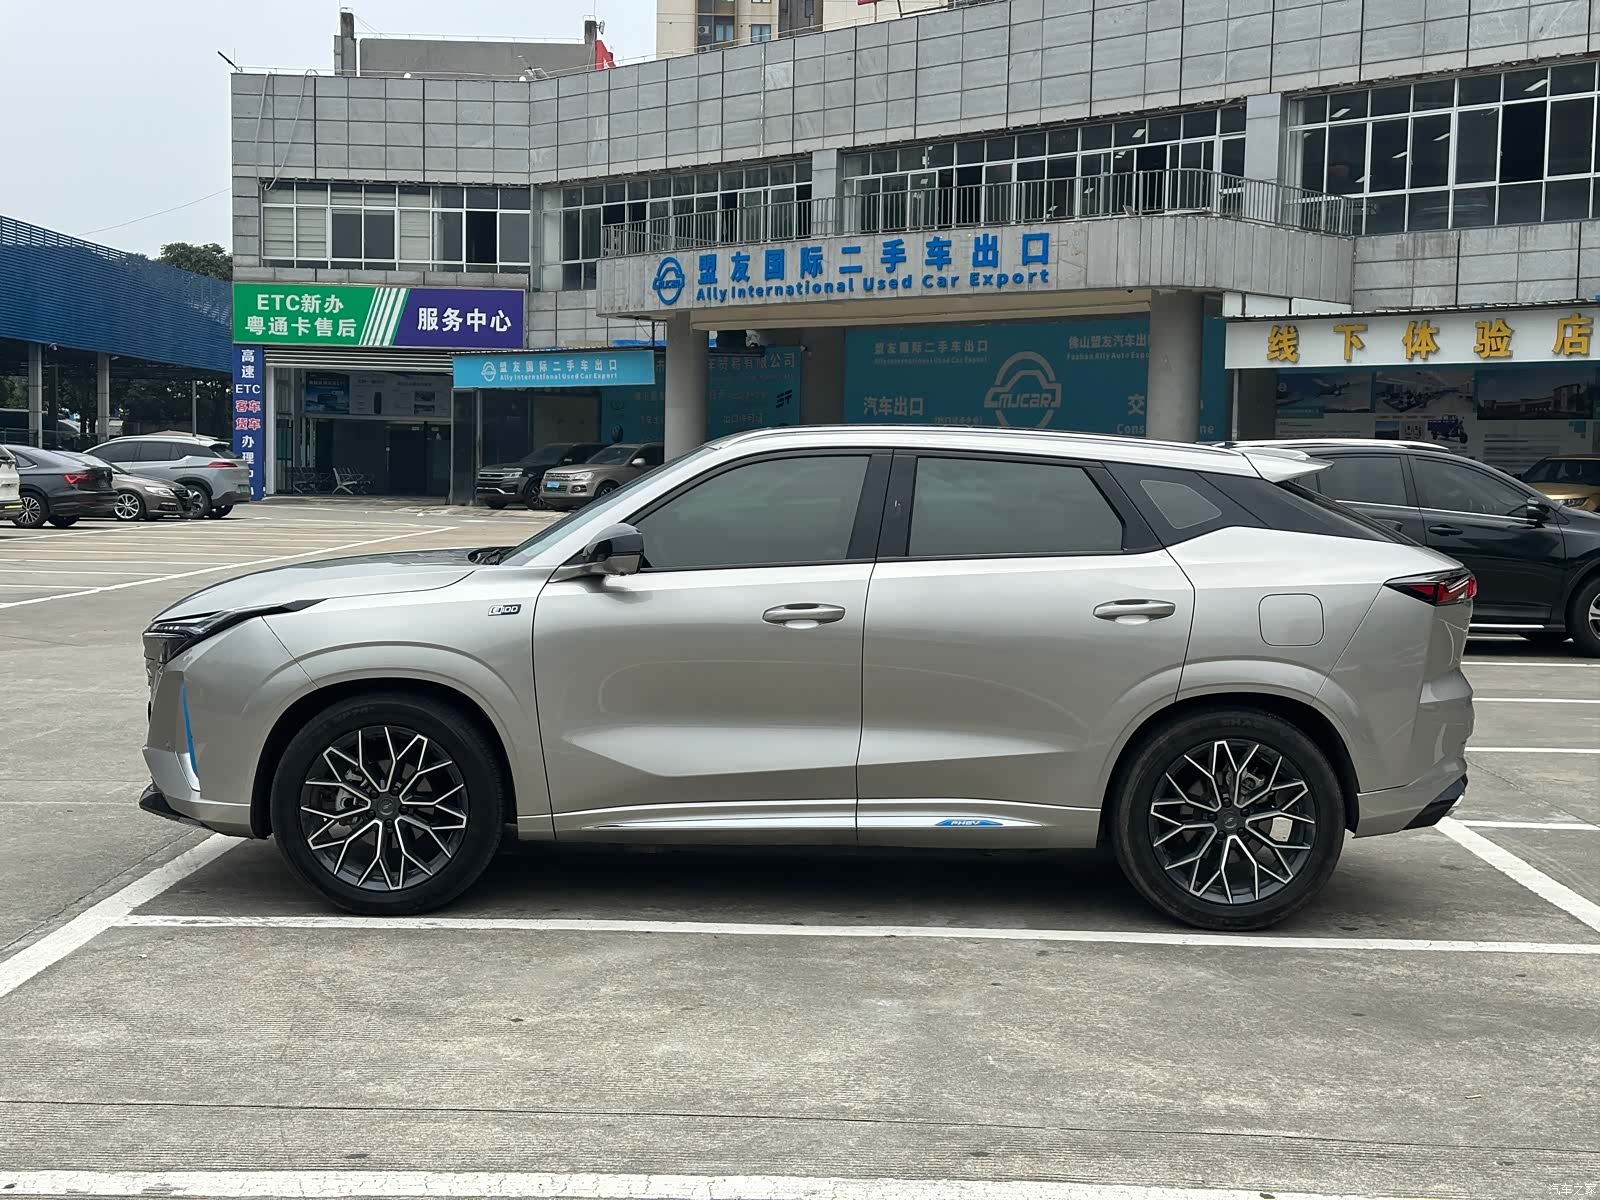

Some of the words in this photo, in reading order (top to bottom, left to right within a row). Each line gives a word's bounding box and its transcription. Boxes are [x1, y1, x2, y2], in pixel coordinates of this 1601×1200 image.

[697, 232, 1050, 286] 盟友国际二手车出口
[696, 286, 727, 303] Ally
[731, 277, 854, 300] International
[863, 274, 912, 291] Used
[922, 273, 959, 289] Car
[970, 269, 1050, 287] Export
[256, 294, 344, 314] ETC新办
[245, 315, 357, 338] 粤通卡售后
[417, 307, 512, 333] 服务中心
[1068, 333, 1152, 349] 佛山盟友汽车出
[1266, 312, 1594, 364] 线下体验店
[500, 359, 617, 373] 盟友国际二手车出口
[500, 374, 513, 382] Ally
[514, 373, 561, 381] International
[593, 373, 617, 381] Export
[235, 383, 261, 394] ETC
[235, 400, 261, 412] 客车
[864, 396, 924, 416] 汽车出口
[235, 417, 261, 431] 货车
